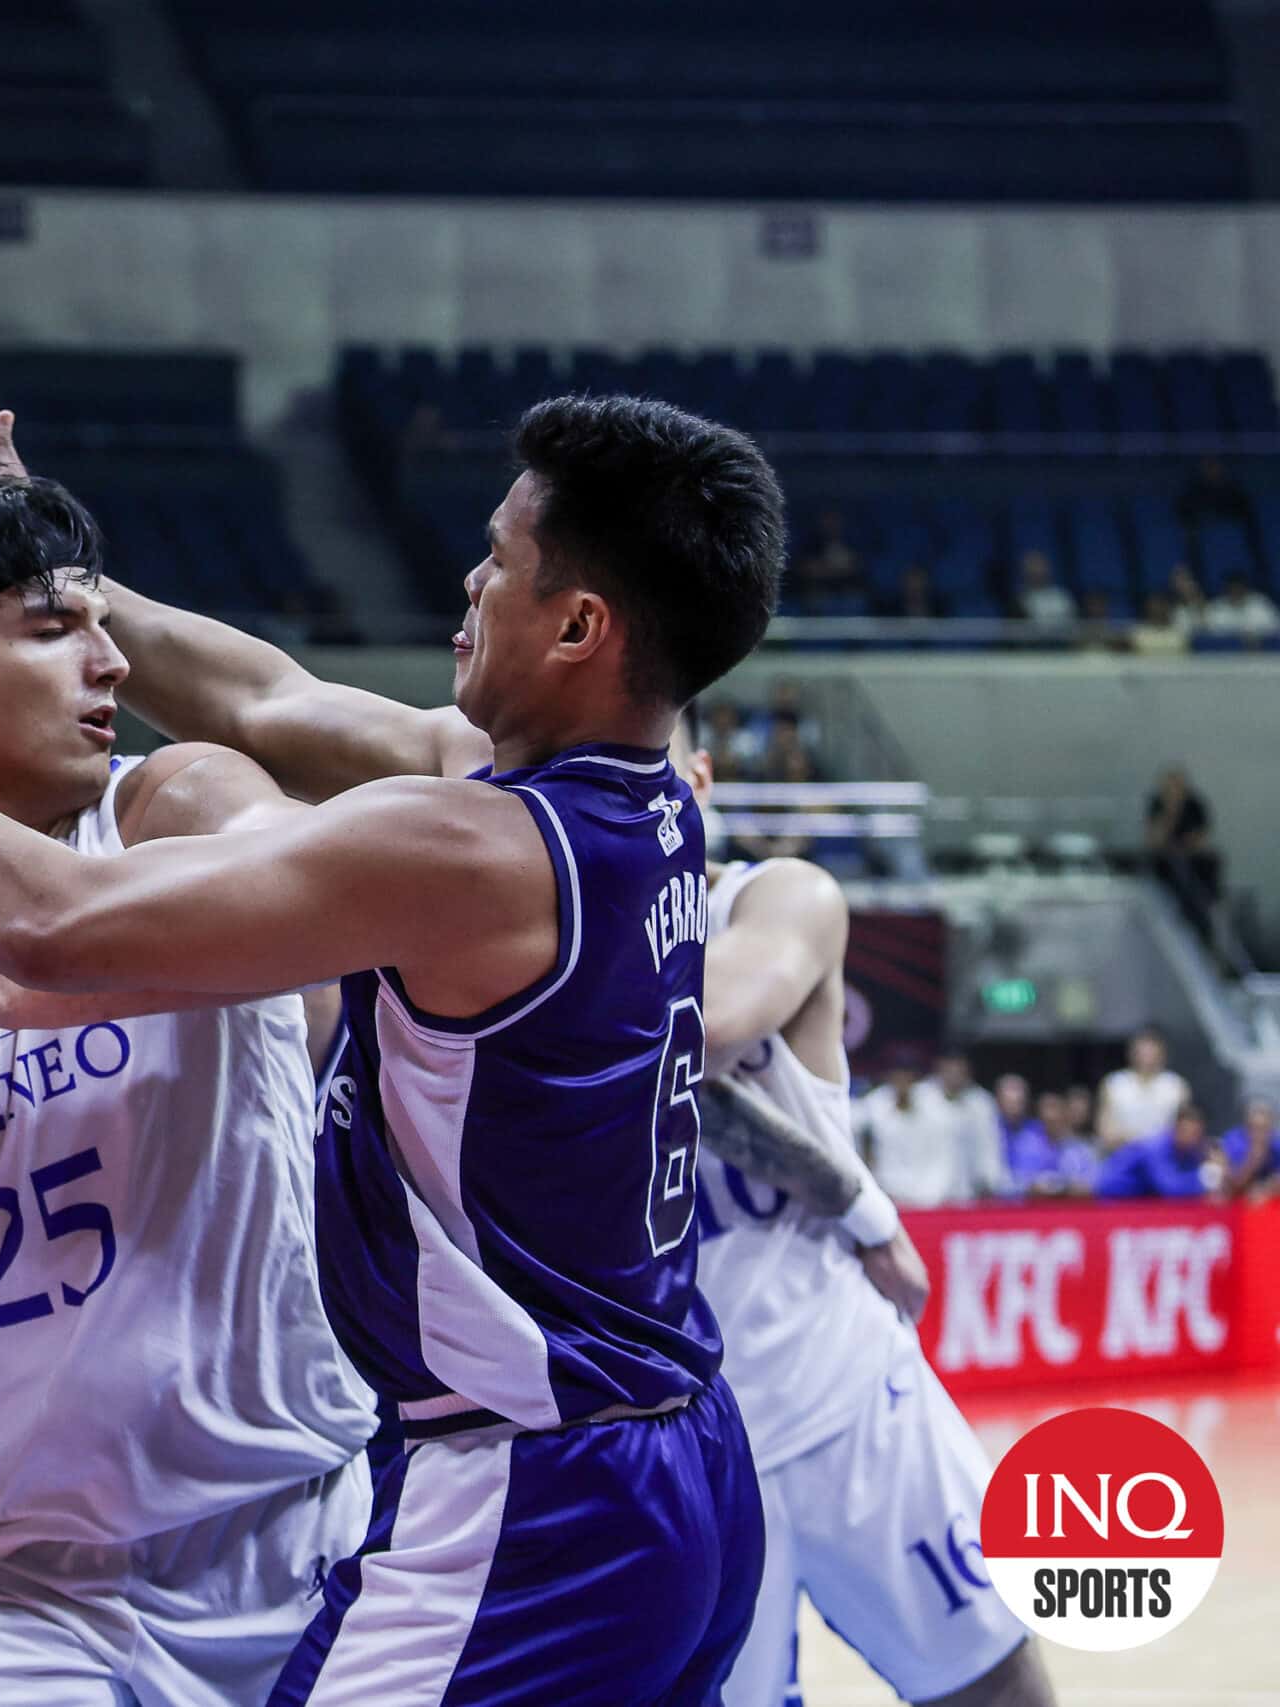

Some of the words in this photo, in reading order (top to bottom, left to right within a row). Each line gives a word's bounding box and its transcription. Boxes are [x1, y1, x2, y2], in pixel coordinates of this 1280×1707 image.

[645, 997, 705, 1258] 6
[937, 1229, 1084, 1370] KFC
[1100, 1225, 1231, 1360] KFC
